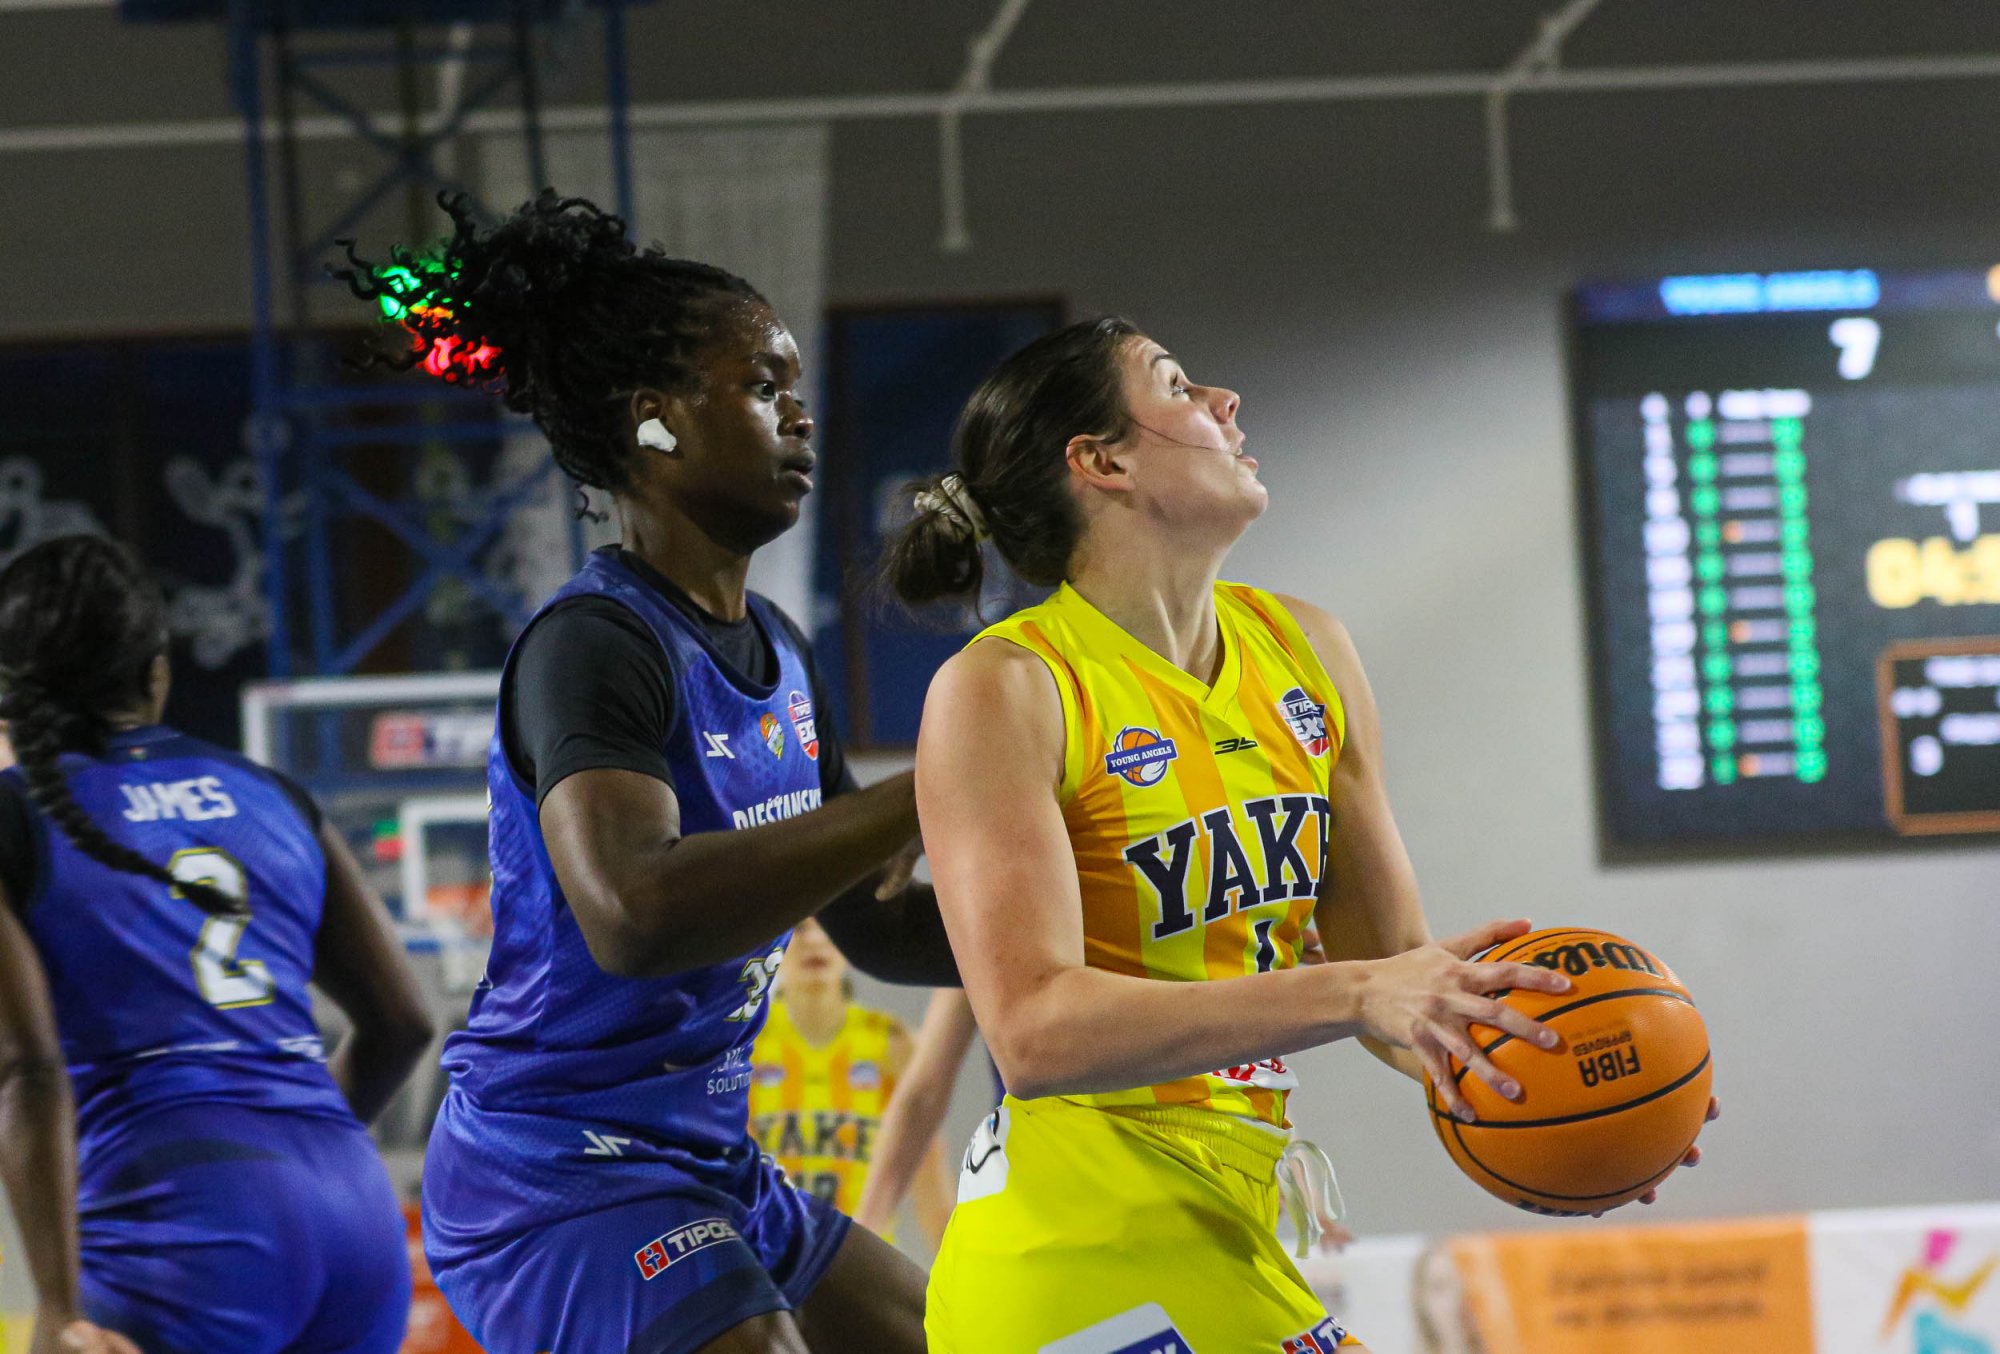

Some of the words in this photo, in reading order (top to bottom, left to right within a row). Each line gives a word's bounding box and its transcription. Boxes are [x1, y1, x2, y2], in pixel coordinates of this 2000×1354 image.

[1111, 753, 1140, 768] YOUNG
[1142, 745, 1172, 760] ANGELS
[119, 775, 239, 822] JAMES
[166, 846, 276, 1010] 2
[1578, 1044, 1642, 1088] FIBA
[667, 1221, 737, 1252] TIPOS
